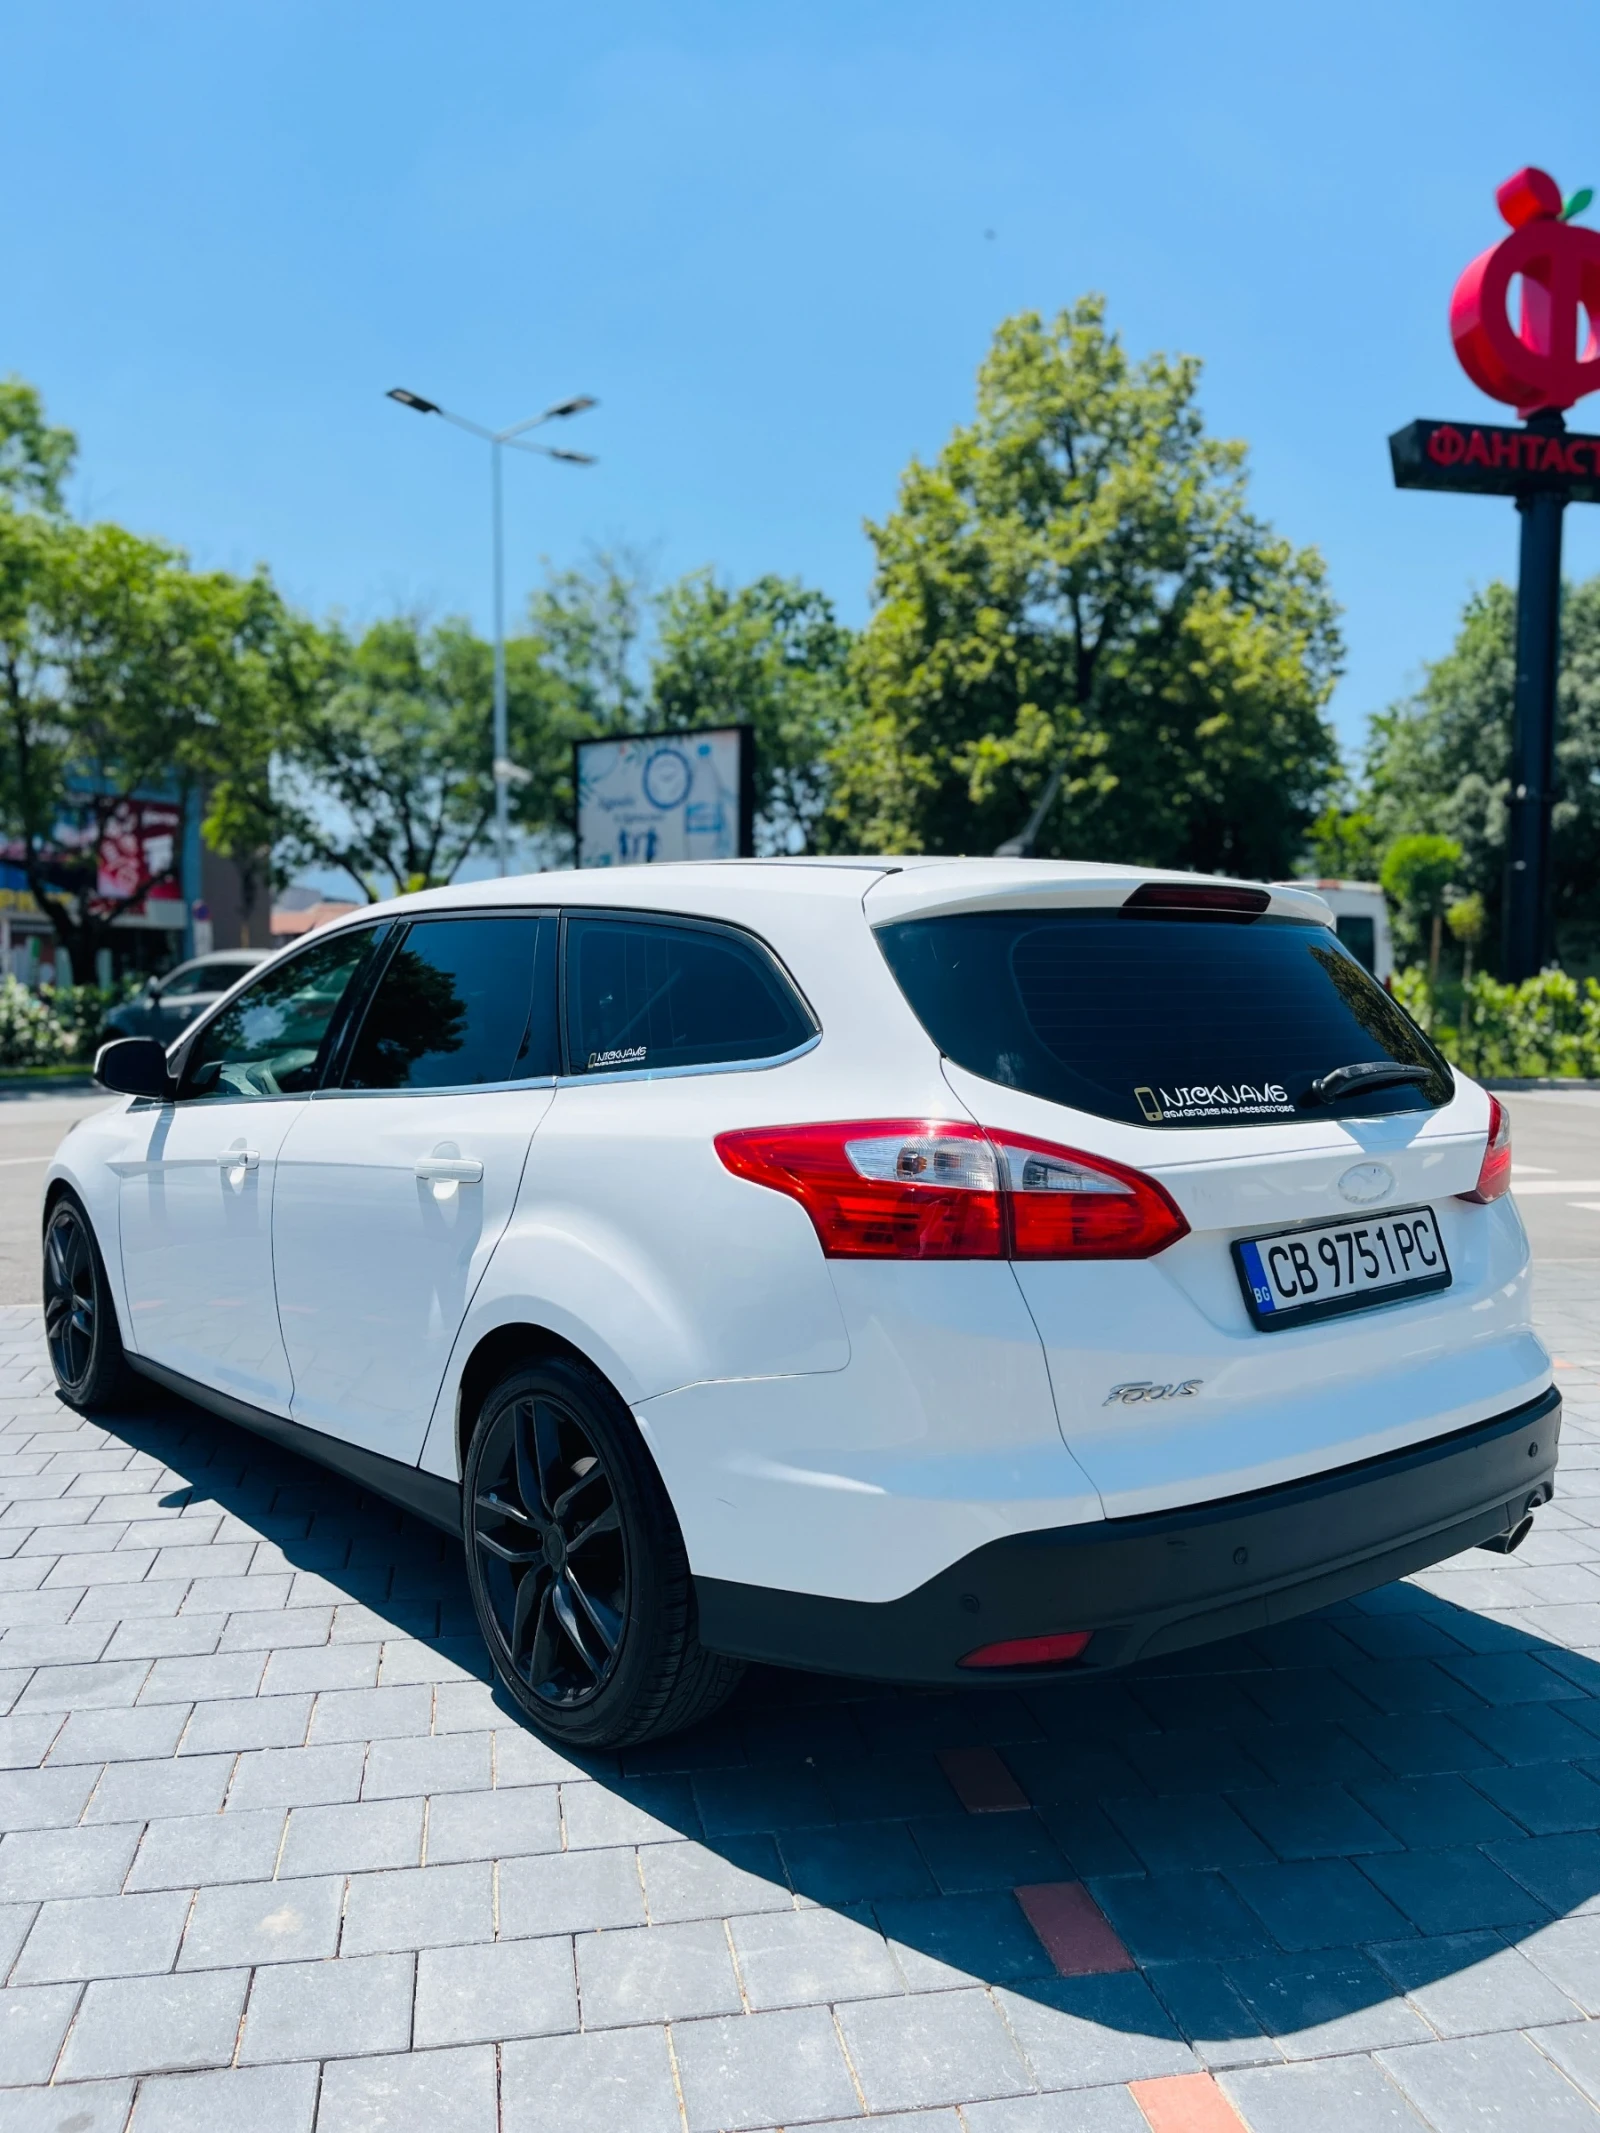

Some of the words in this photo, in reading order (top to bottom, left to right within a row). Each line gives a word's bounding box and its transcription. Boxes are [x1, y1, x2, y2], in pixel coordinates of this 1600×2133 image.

[1221, 1106, 1238, 1115] AND
[1268, 1242, 1318, 1298] CB
[1318, 1226, 1396, 1287] 9751
[1393, 1219, 1437, 1271] PC
[1253, 1287, 1271, 1303] BG
